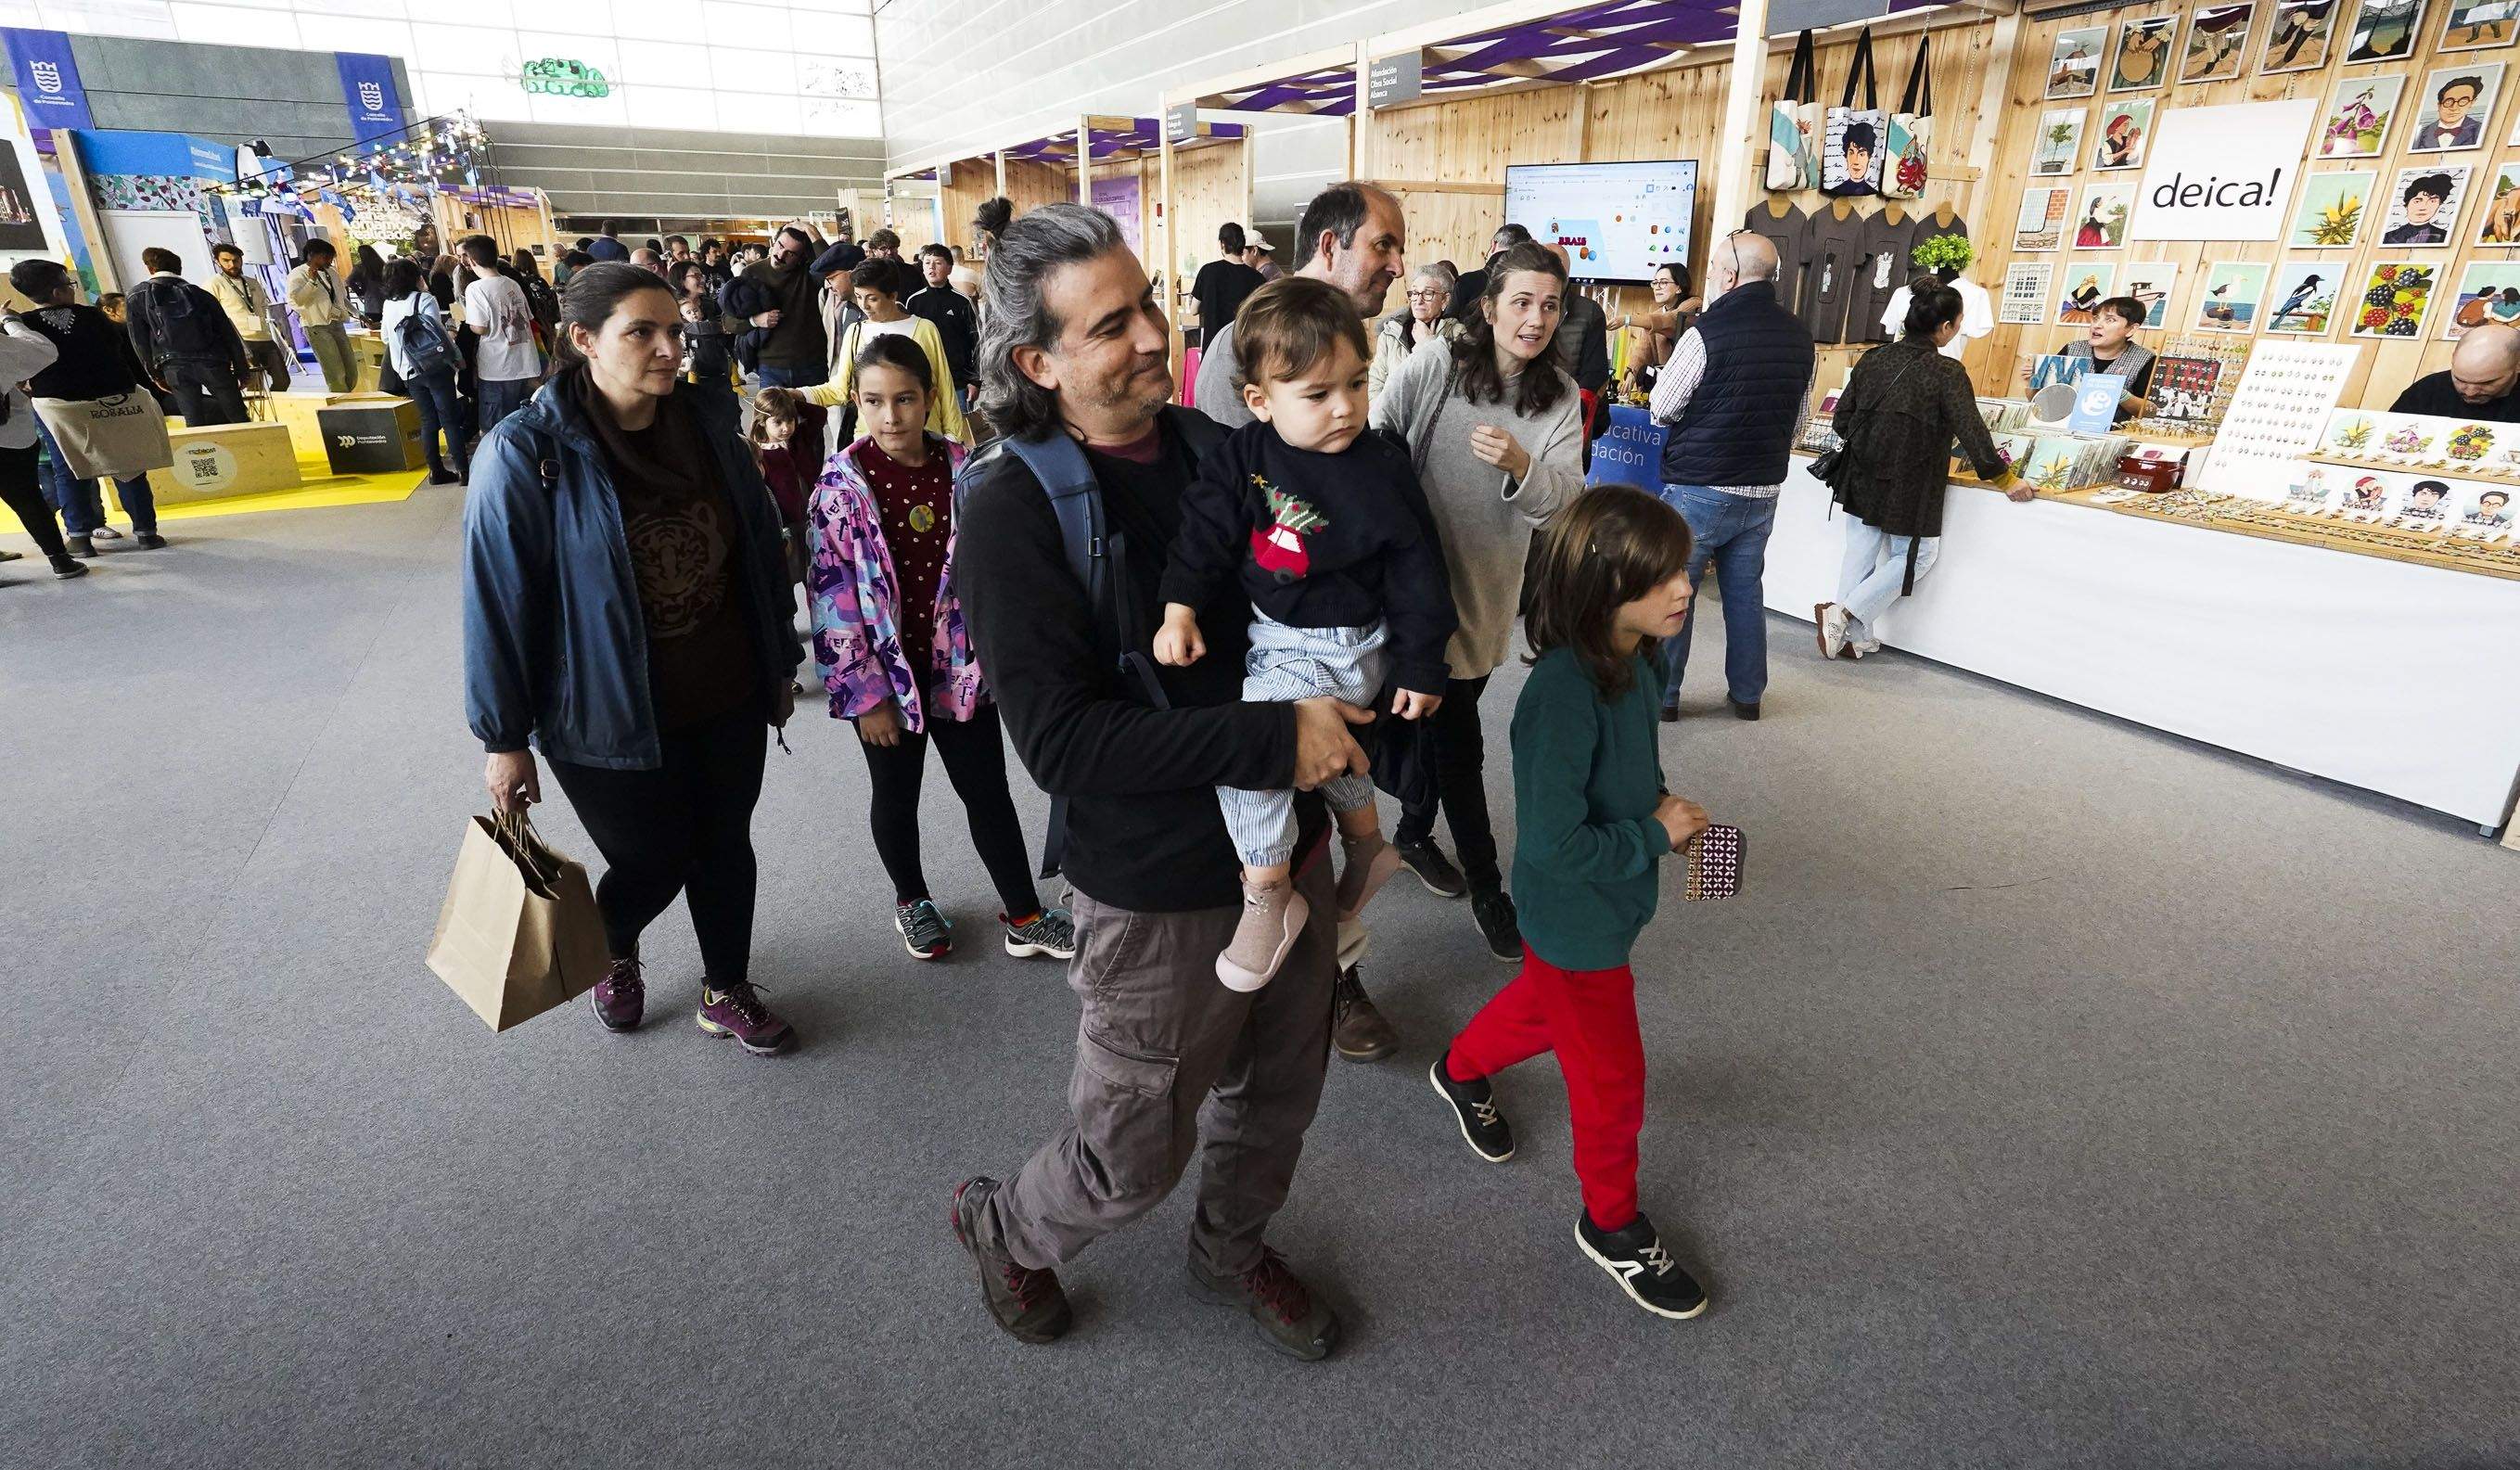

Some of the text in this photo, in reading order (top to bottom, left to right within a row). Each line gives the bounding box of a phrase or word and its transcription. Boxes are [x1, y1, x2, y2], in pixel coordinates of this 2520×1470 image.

[1371, 67, 1398, 78] Afundación
[1371, 76, 1398, 89] Obra Social
[1370, 90, 1388, 99] Abanca
[2153, 168, 2282, 208] deica!
